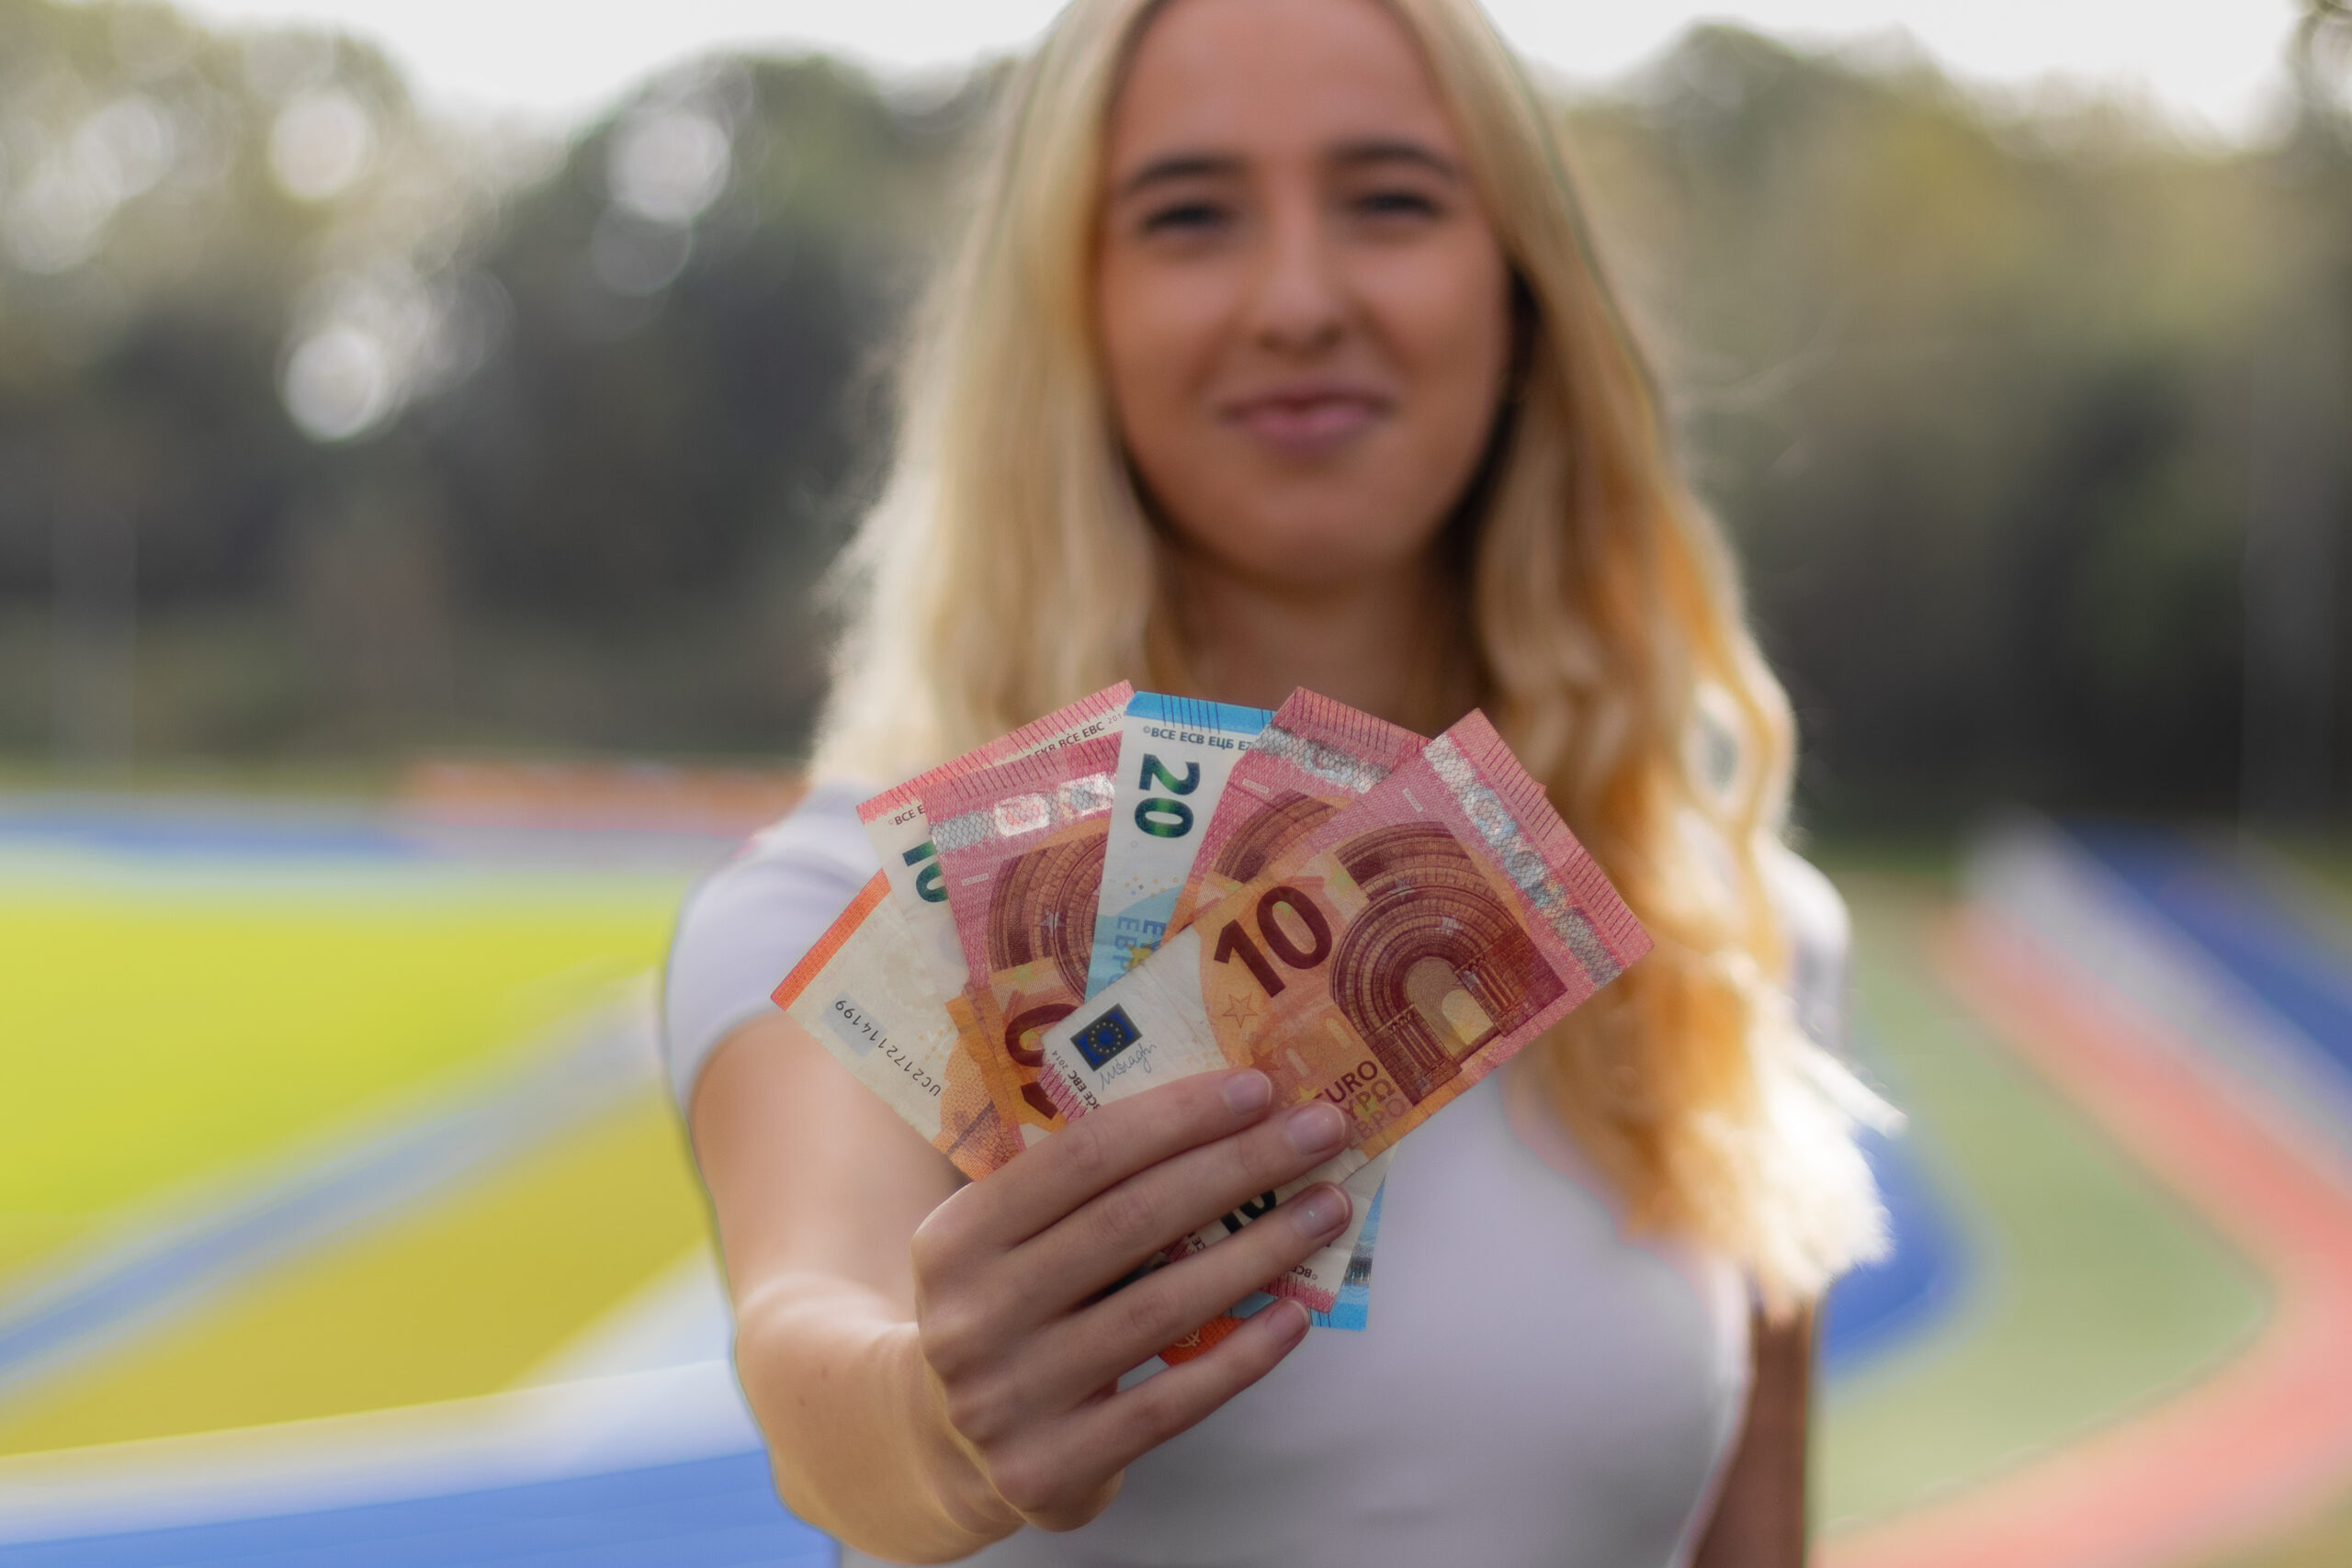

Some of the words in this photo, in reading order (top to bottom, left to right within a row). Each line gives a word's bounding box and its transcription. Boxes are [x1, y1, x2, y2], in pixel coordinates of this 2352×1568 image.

[1082, 720, 1105, 739] EBC
[1180, 732, 1204, 745] ECB
[1238, 739, 1252, 751] EZ
[1134, 752, 1201, 839] 20
[1213, 886, 1333, 998] 10
[834, 999, 942, 1097] UC2172114199
[1051, 1050, 1069, 1069] 2014
[1068, 1069, 1087, 1092] EBC
[1313, 1060, 1378, 1103] URO
